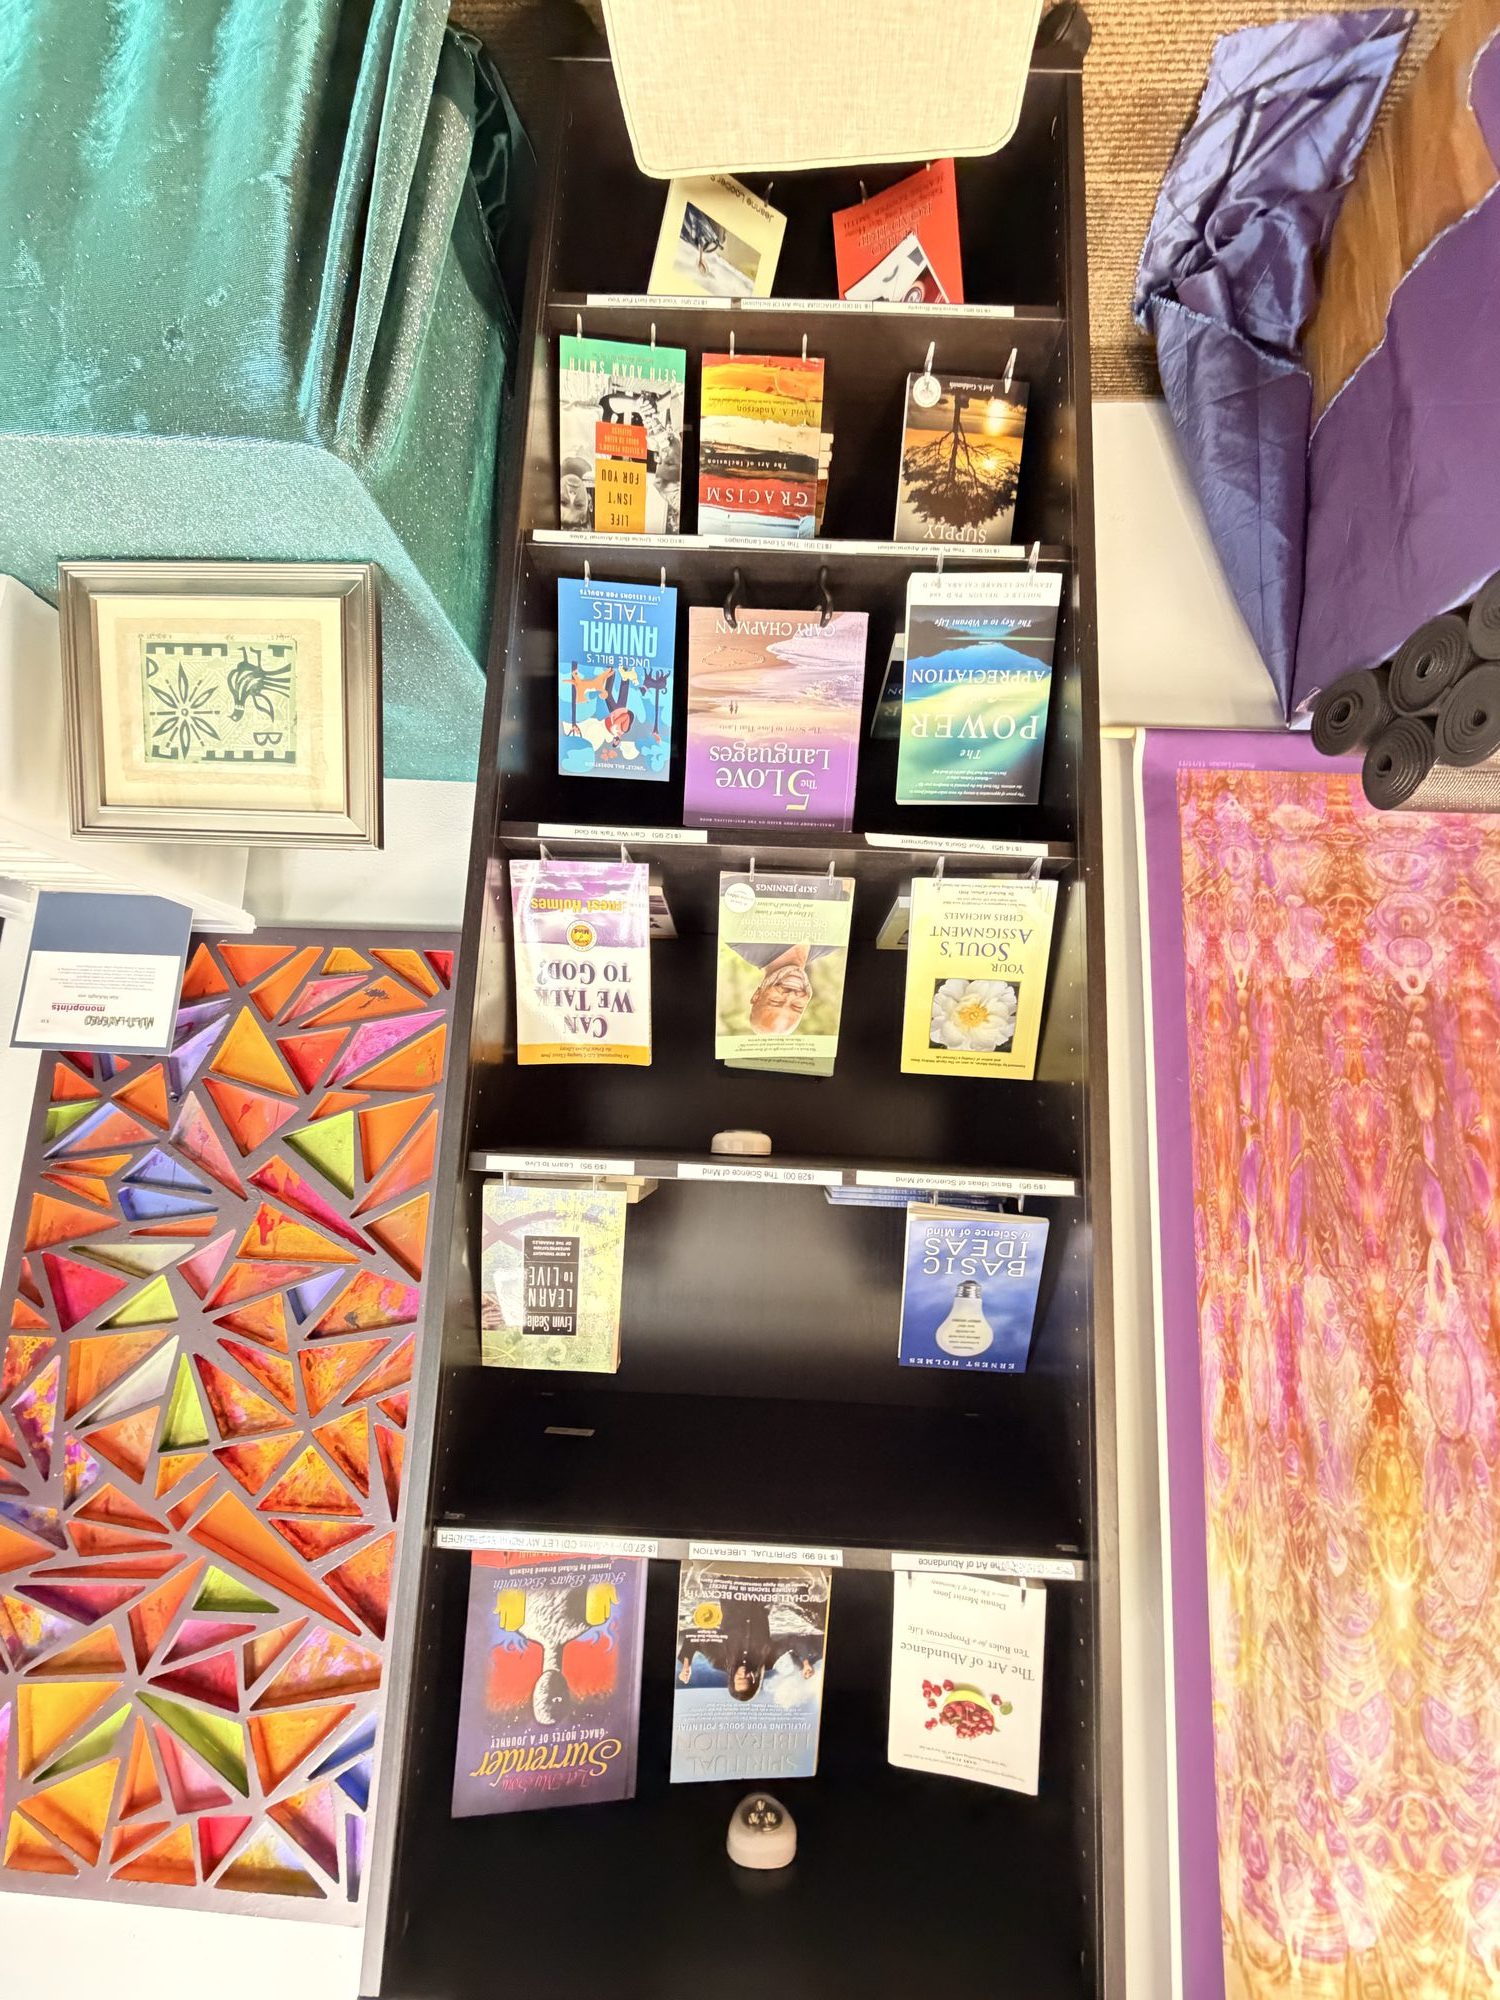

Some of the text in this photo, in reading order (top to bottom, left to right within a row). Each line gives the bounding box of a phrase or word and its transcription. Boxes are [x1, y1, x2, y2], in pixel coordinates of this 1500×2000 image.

[746, 197, 774, 223] Jeanne
[736, 405, 776, 416] Anderson
[790, 408, 815, 418] David
[706, 458, 787, 469] The Art of Inclusion
[600, 468, 640, 485] FOR YOU
[607, 491, 633, 506] ISN'T
[705, 486, 808, 507] GRACISM
[609, 512, 629, 528] LIFE
[922, 524, 987, 544] SUPPLY
[619, 592, 647, 601] LESSONS
[592, 600, 648, 624] TALES
[933, 616, 950, 627] Life
[951, 618, 980, 628] Vibrant
[989, 618, 997, 626] to
[998, 617, 1015, 627] Key
[1017, 618, 1032, 628] The
[714, 620, 836, 639] GARY CHAPMAN
[579, 620, 658, 658] ANIMAL
[585, 653, 650, 668] UNCLE BILL'S
[908, 668, 1046, 684] APPRECIATION
[909, 713, 1040, 740] POWER
[708, 741, 831, 770] Languages
[958, 749, 981, 760] The
[714, 766, 815, 813] 5 Love
[799, 778, 817, 790] The
[754, 882, 818, 895] SKIP JENNINGS
[529, 896, 582, 912] Holmes
[943, 911, 1024, 922] CHRIS MICHAELS
[929, 925, 1033, 945] ASSIGNMENT
[939, 941, 1011, 961] SOUL'S
[535, 959, 631, 986] TO GOD?
[991, 962, 1025, 974] YOUR
[51, 1003, 106, 1012] monoprints
[596, 990, 634, 1014] WE
[84, 1015, 154, 1030] MULTI-LAYERED
[563, 1016, 608, 1039] CAN
[702, 1168, 778, 1179] The Science of Mind
[925, 1178, 957, 1186] Science
[967, 1180, 989, 1188] Ideas
[990, 1181, 1012, 1189] Basic
[926, 1227, 1018, 1240] Science of Mind
[922, 1238, 1030, 1258] IDEAS
[922, 1256, 1027, 1277] BASIC
[527, 1266, 573, 1286] to LIVE
[527, 1287, 574, 1308] LEARN
[526, 1314, 573, 1333] Ervin Seale
[907, 1357, 1016, 1370] ERNEST HOLMES
[692, 1546, 797, 1559] SPIRITUAL LIBERATION
[918, 1558, 964, 1570] Abundance
[965, 1560, 975, 1570] of
[975, 1561, 989, 1571] Art
[732, 1590, 778, 1601] BERNARD
[932, 1588, 952, 1600] Jones
[907, 1625, 1030, 1658] Ten Rules Prosperous Life
[899, 1640, 1035, 1682] The Art of Abundance
[490, 1727, 605, 1749] GRACE NOTES OF A JOURNEY
[469, 1738, 621, 1787] Surrender
[686, 1754, 797, 1773] SPIRITUAL
